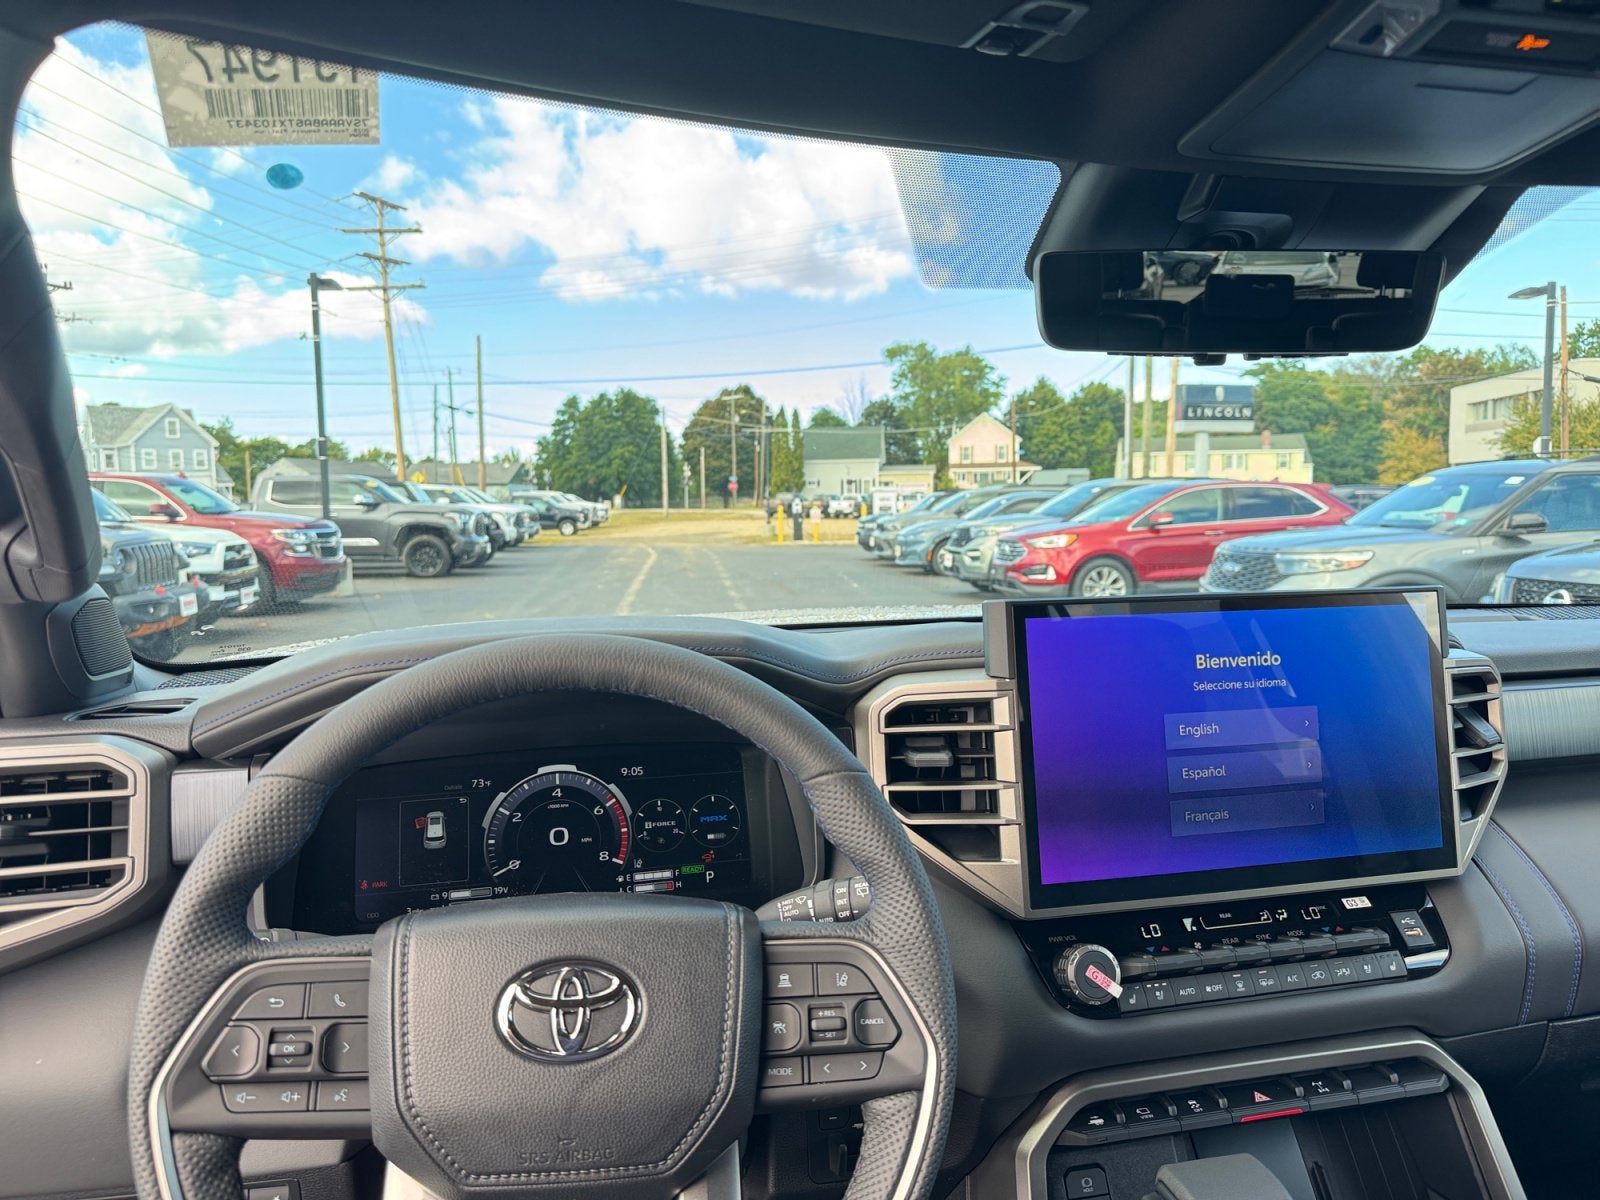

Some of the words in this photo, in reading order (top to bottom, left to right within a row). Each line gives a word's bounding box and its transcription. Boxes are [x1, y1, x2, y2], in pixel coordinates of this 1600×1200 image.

[1187, 407, 1252, 418] LINCOLN
[1195, 651, 1282, 669] Bienvenido
[1193, 680, 1243, 691] Seleccione
[1244, 681, 1255, 689] su
[1256, 678, 1287, 688] idioma
[1179, 724, 1220, 737] English
[620, 766, 644, 776] 9:05
[1182, 766, 1227, 780] Español
[551, 788, 563, 798] 4
[593, 806, 604, 815] 6
[511, 812, 523, 823] 2
[700, 815, 728, 823] MAX
[1185, 810, 1230, 823] Français
[548, 827, 570, 846] 0
[599, 851, 610, 861] 8
[705, 871, 715, 884] P
[784, 910, 799, 918] AUTO
[838, 911, 851, 919] OFF
[1301, 906, 1321, 920] LO
[1141, 924, 1162, 939] LO
[1222, 937, 1240, 945] REAR
[1287, 975, 1299, 983] A/C
[1179, 988, 1196, 996] AUTO
[1211, 984, 1223, 992] OFF
[283, 1045, 296, 1053] OK
[768, 1067, 793, 1076] MODE
[518, 1151, 550, 1166] SRS
[555, 1147, 616, 1163] AIRBAG
